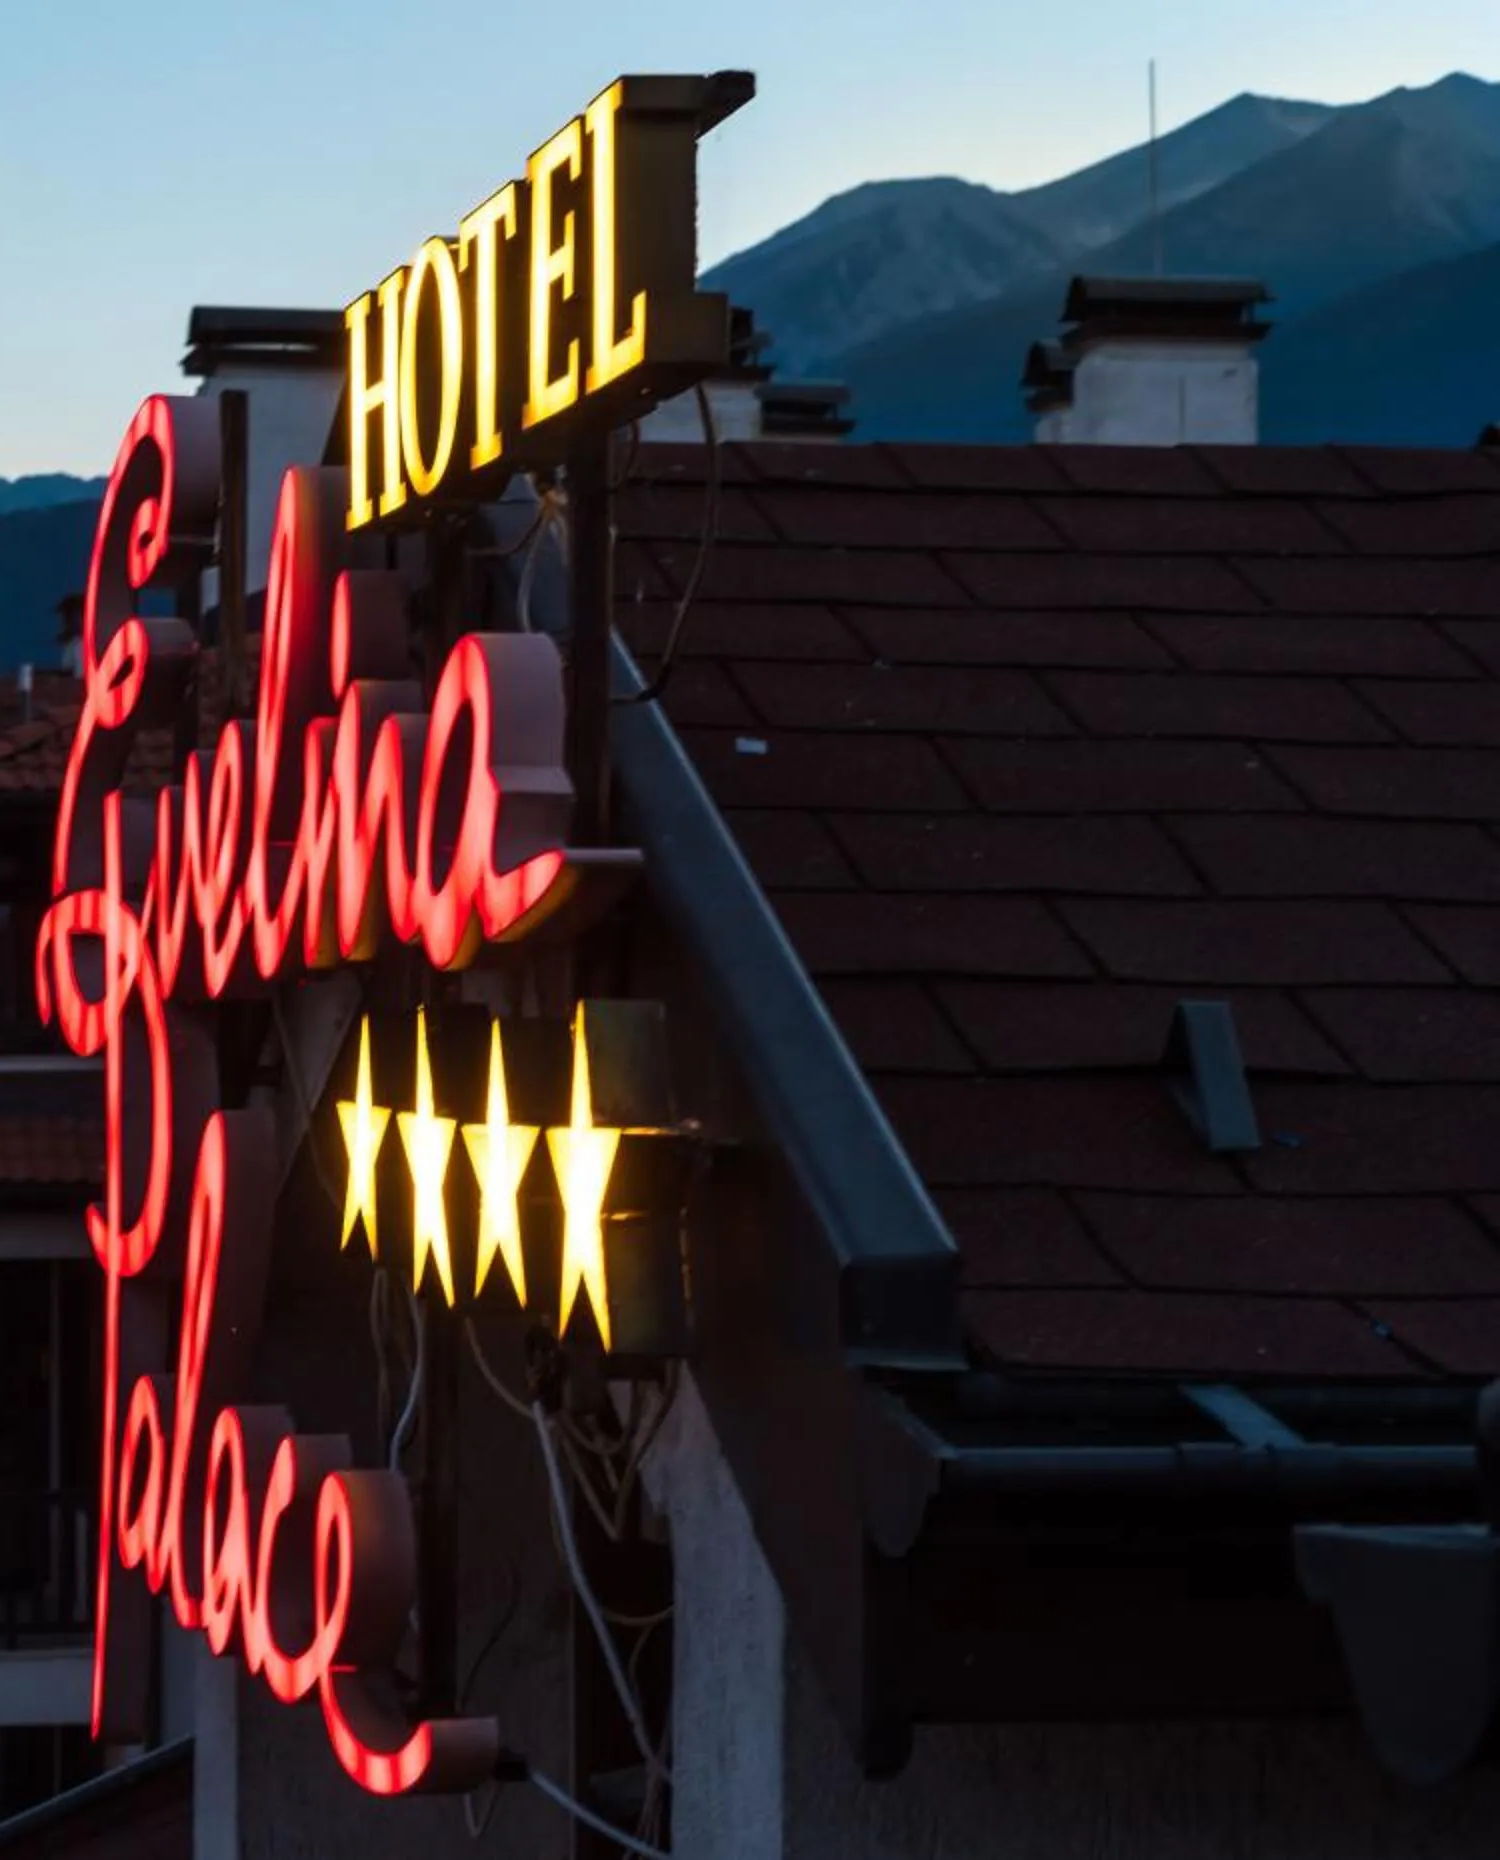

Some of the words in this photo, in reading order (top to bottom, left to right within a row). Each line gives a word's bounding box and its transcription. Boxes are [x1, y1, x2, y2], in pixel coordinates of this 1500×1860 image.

[344, 78, 647, 531] HOTEL
[48, 394, 566, 1058] Evelina
[35, 788, 432, 1797] Palace
